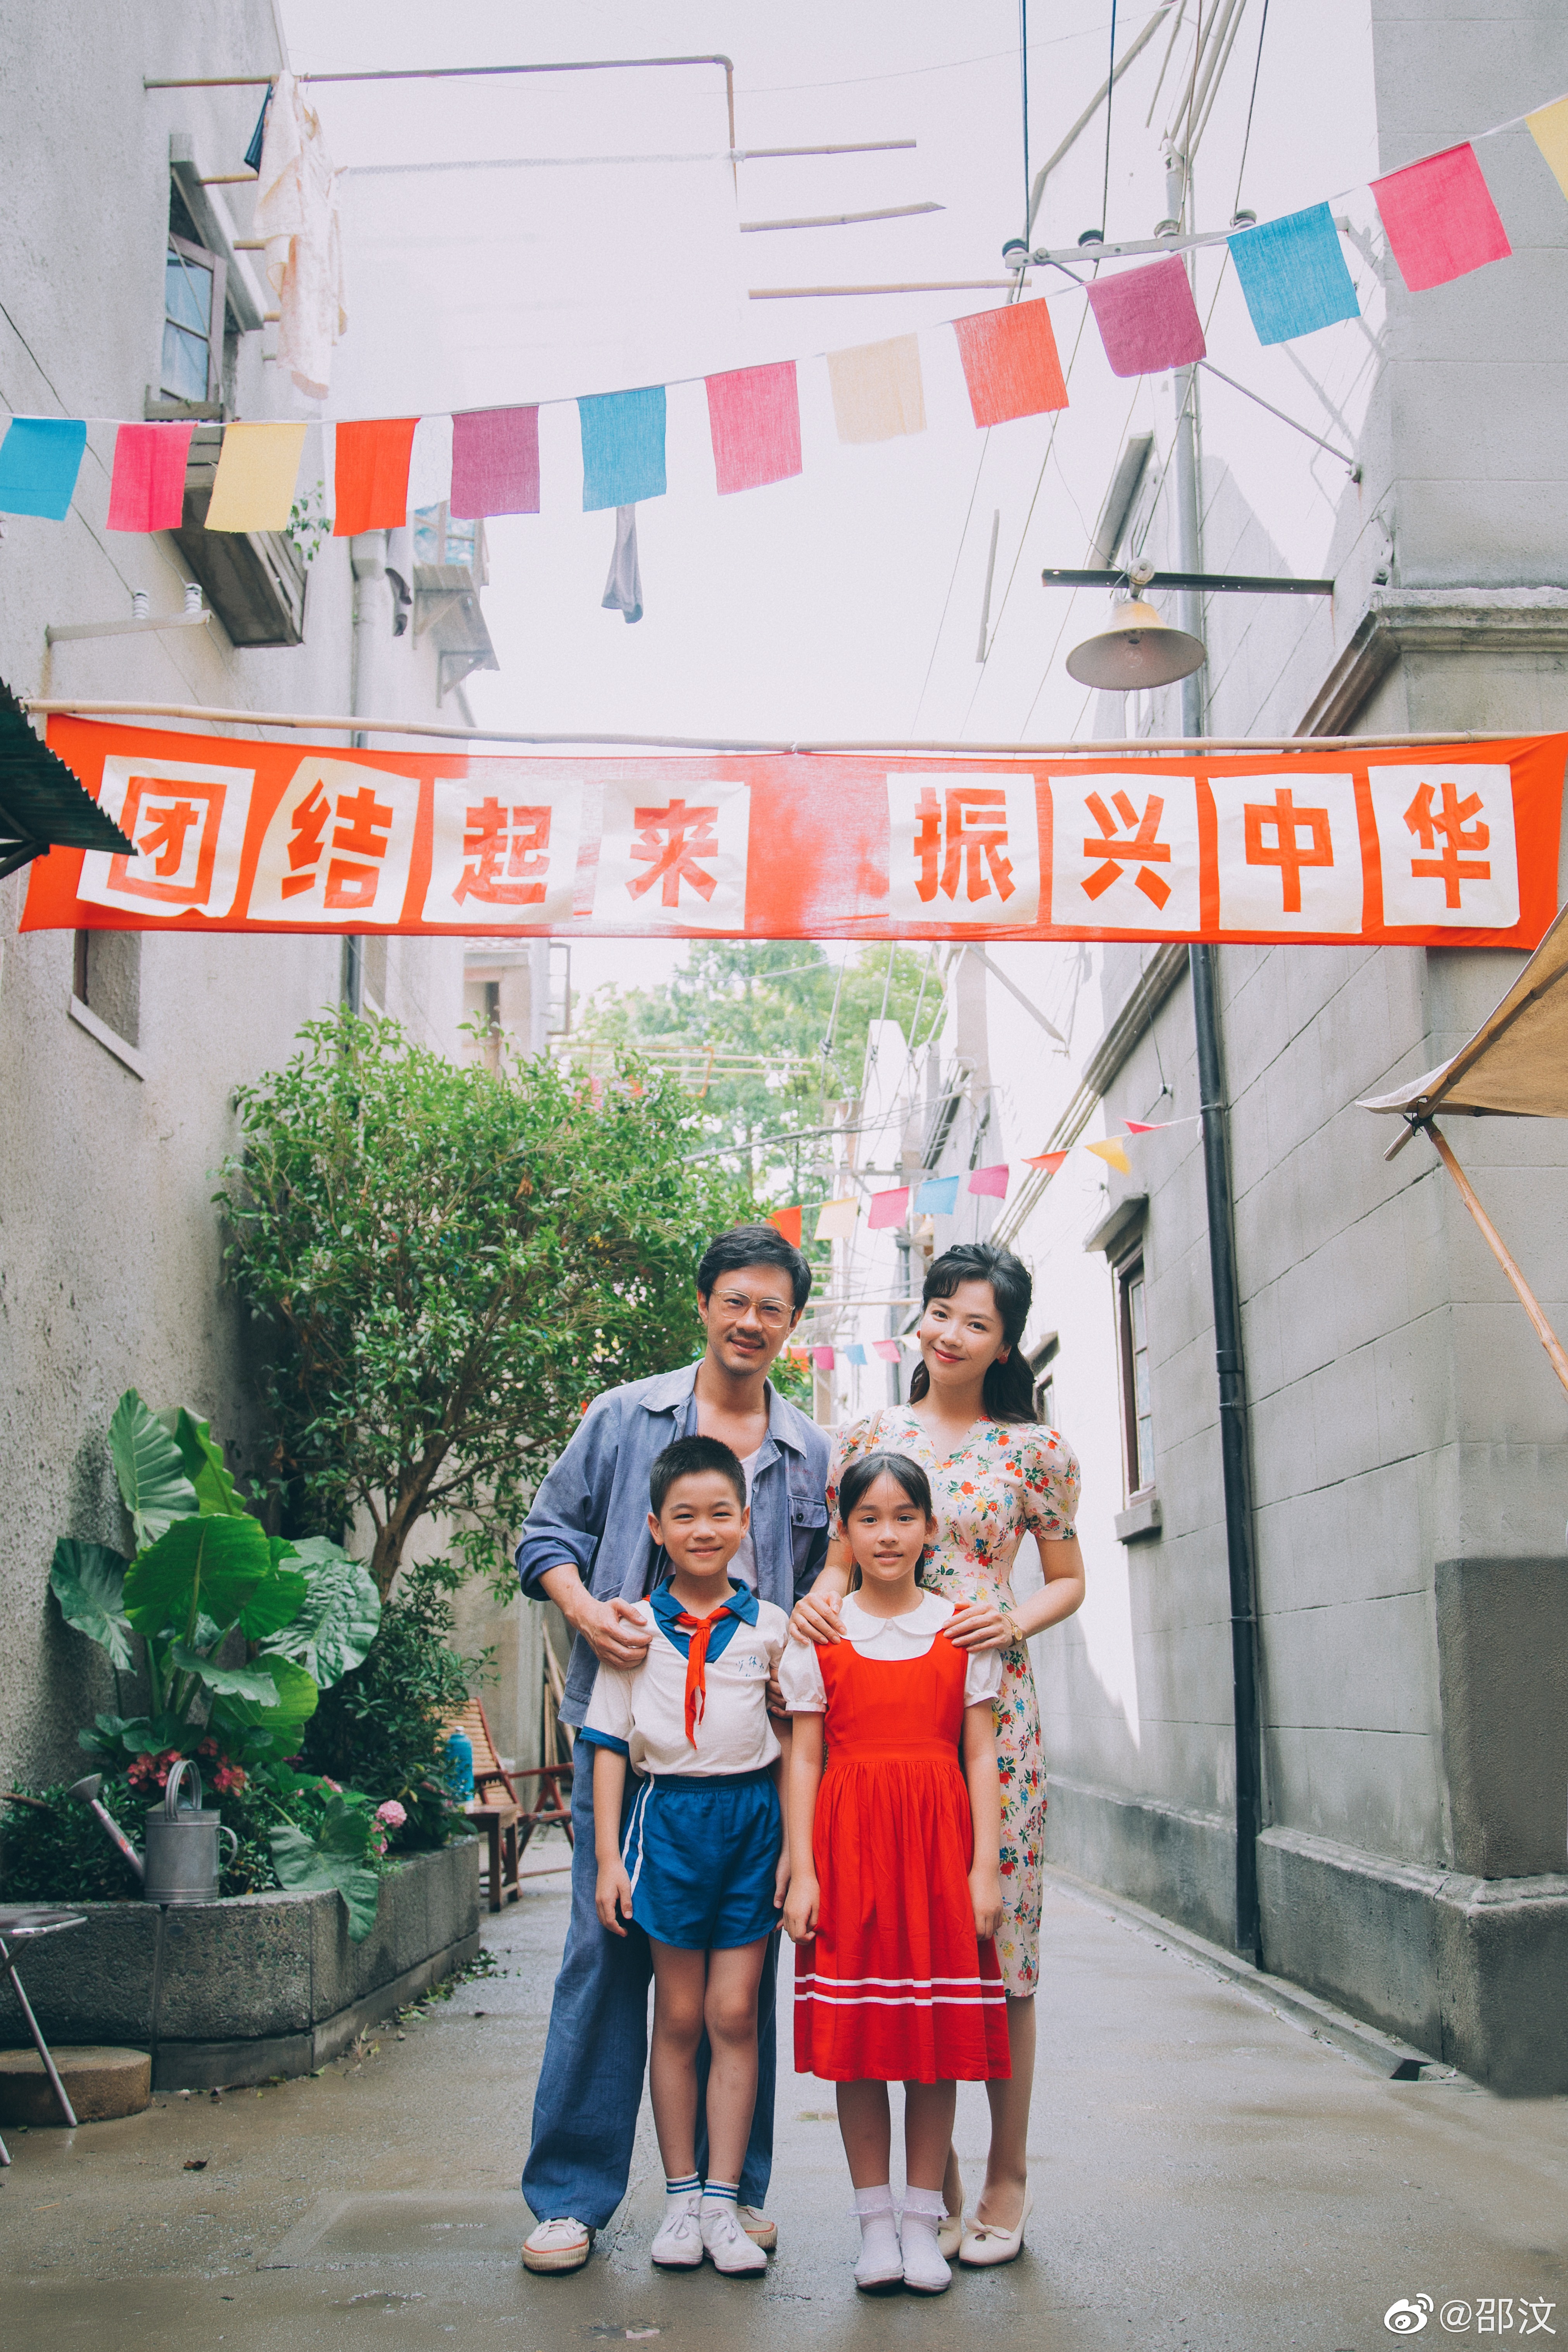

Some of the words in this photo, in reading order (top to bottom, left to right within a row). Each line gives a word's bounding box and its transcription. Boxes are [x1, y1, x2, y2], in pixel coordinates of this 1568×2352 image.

[107, 776, 719, 908] 团结起来
[914, 782, 1490, 913] 振兴中华
